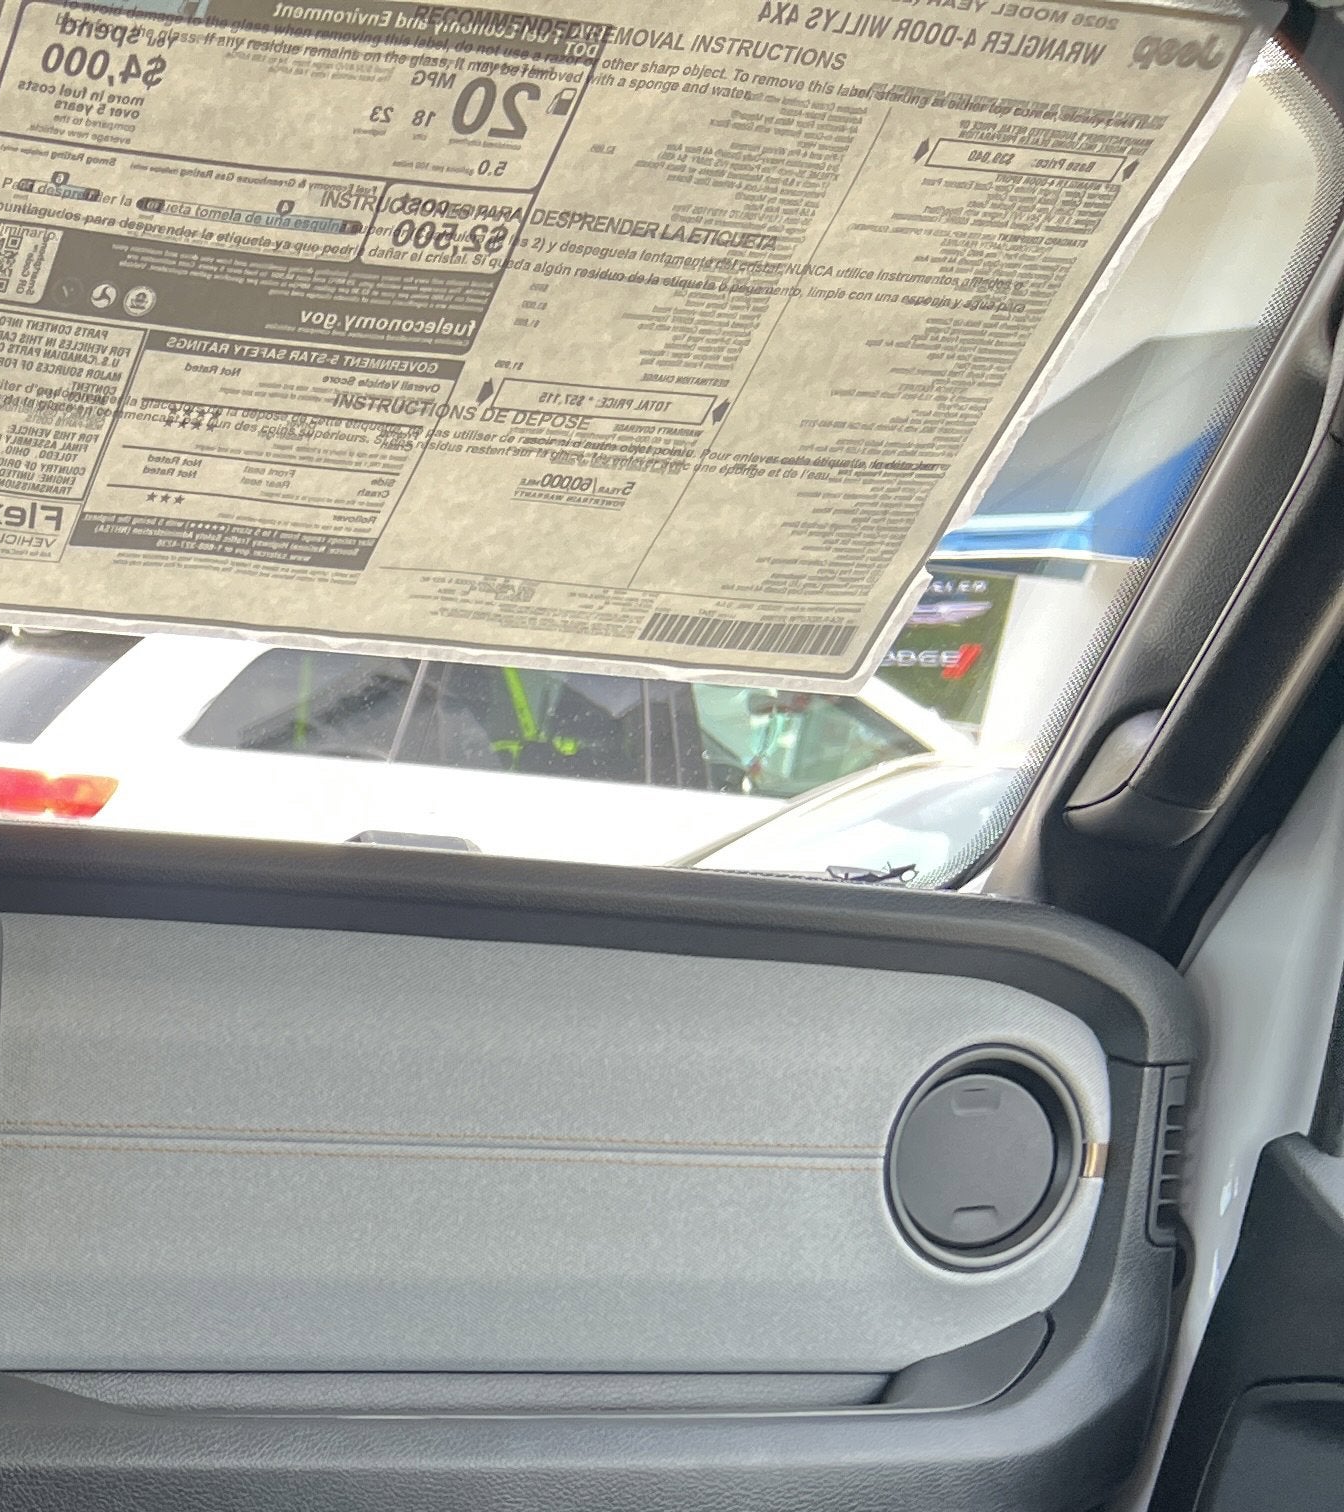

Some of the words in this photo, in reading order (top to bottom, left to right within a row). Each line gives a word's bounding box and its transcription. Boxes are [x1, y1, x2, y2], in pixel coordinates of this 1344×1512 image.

[690, 33, 848, 71] INSTRUCTIONS
[602, 58, 638, 74] other
[641, 61, 680, 78] sharp
[733, 69, 750, 83] To
[753, 72, 804, 90] remove
[807, 79, 833, 95] this
[529, 210, 657, 240] DESPRENDER
[480, 407, 507, 424] DE
[880, 650, 961, 667] ODGE
